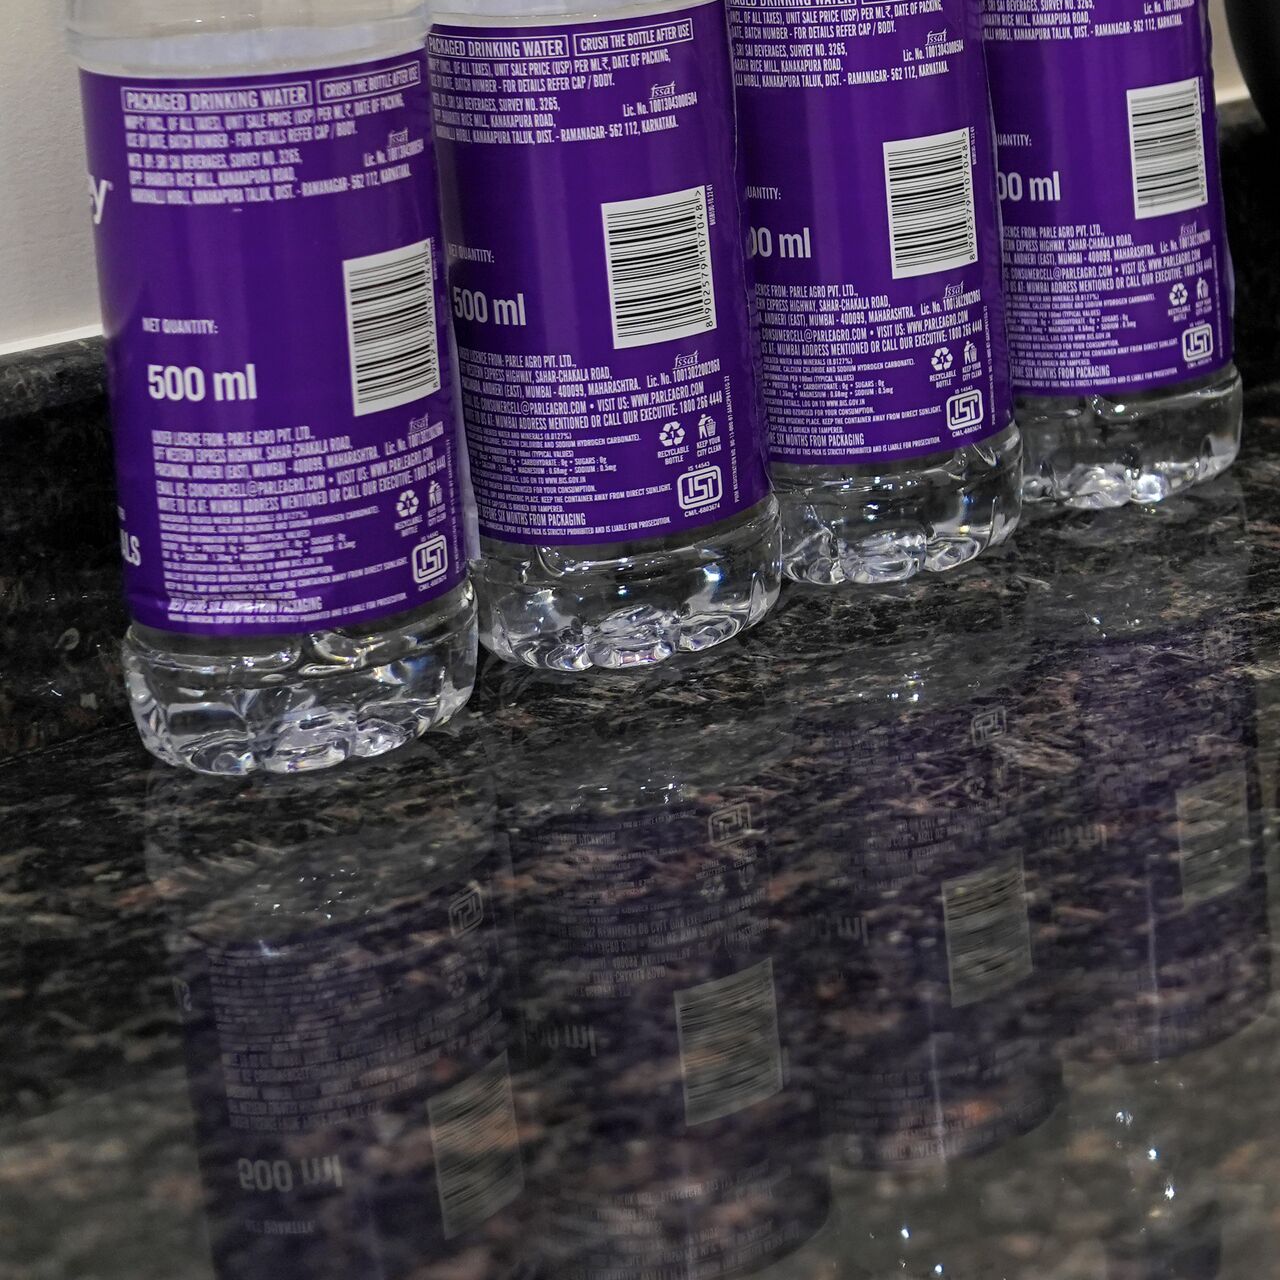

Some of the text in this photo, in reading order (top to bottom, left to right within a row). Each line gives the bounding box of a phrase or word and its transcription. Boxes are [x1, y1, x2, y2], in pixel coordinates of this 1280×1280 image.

[427, 36, 565, 58] PACKAGED DRINKING WATER
[579, 22, 690, 51] CRUSH THE BOTTLE AFTER USE
[493, 62, 509, 76] UNIT
[509, 61, 528, 76] SALE
[527, 61, 551, 76] PRICE
[551, 59, 572, 75] (USP)
[573, 58, 589, 73] PER
[611, 53, 630, 69] DATE
[629, 52, 640, 67] OF
[471, 78, 497, 92] NUMBER
[501, 78, 517, 93] FOR
[516, 77, 546, 93] DETAILS
[545, 76, 570, 91] REFER
[570, 74, 586, 90] CAP
[125, 85, 307, 112] PACKAGED DRINKING WATER
[498, 97, 523, 112] SURVEY
[559, 124, 608, 142] RAMANAGAR-
[608, 122, 623, 138] 562
[997, 133, 1032, 147] UANTITY:
[747, 186, 782, 200] UANTITY:
[1029, 171, 1061, 201] ml
[778, 227, 812, 258] ml
[453, 286, 527, 326] 500 ml
[142, 317, 219, 334] NET QUANTITY:
[504, 354, 524, 368] PARLE
[524, 354, 542, 368] AGRO
[148, 363, 258, 402] 500 ml
[534, 367, 589, 383] SAHAR-CHAKALA
[524, 384, 552, 398] MUMBAI
[596, 380, 704, 412] VISIT US: WWW.PARLEAGRO.COM
[547, 402, 678, 430] MENTIONED OR CALL OUR EXECUTIVE:
[528, 511, 586, 526] FROM PACKAGING
